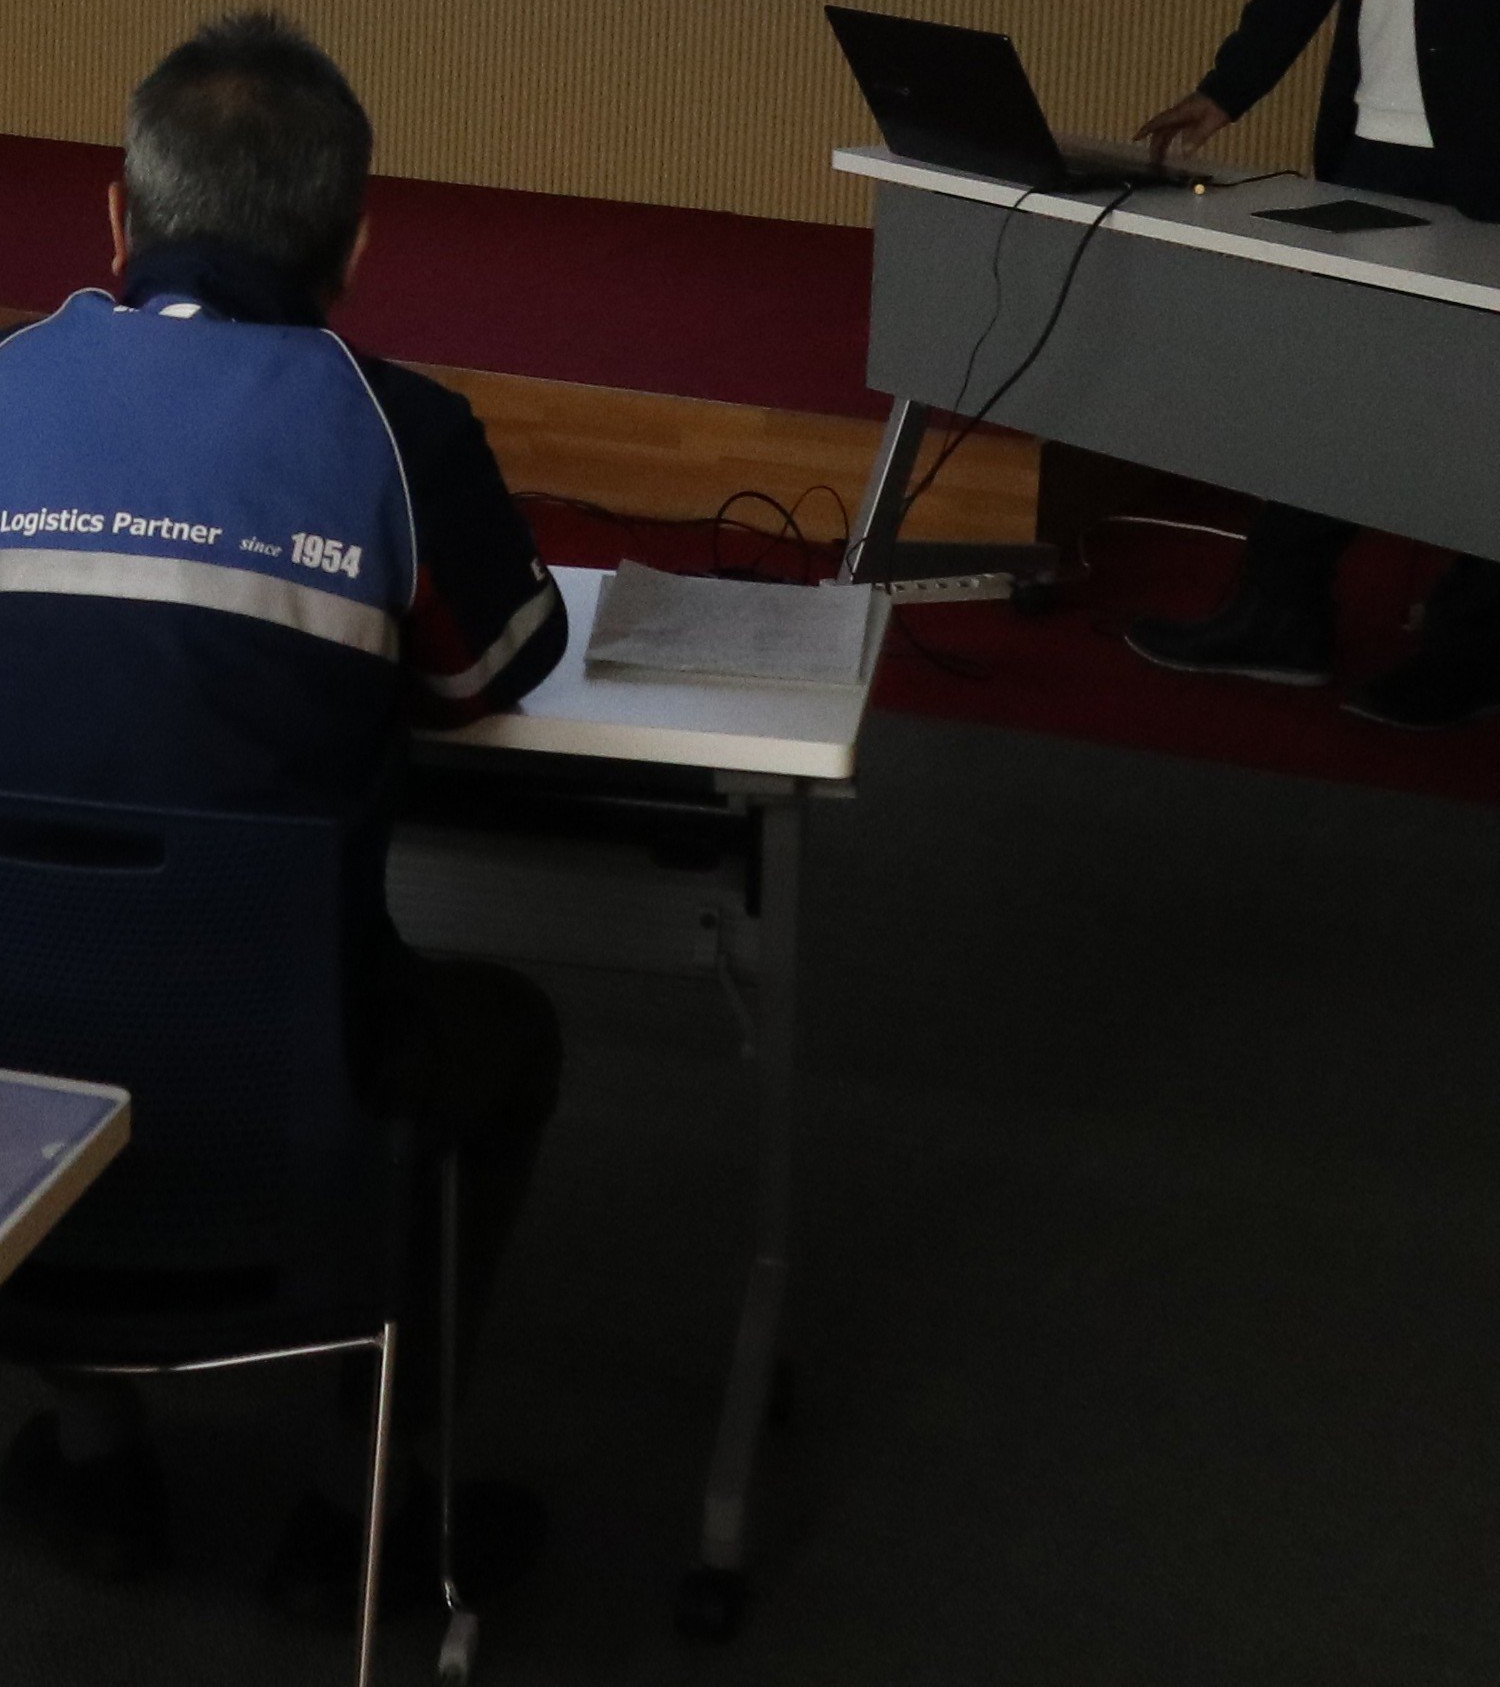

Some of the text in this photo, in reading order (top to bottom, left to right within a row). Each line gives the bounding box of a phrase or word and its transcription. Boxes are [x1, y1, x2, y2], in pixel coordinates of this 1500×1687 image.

[0, 508, 104, 538] Logistics
[111, 511, 223, 545] Partner
[238, 535, 284, 559] since
[289, 531, 364, 580] 1954
